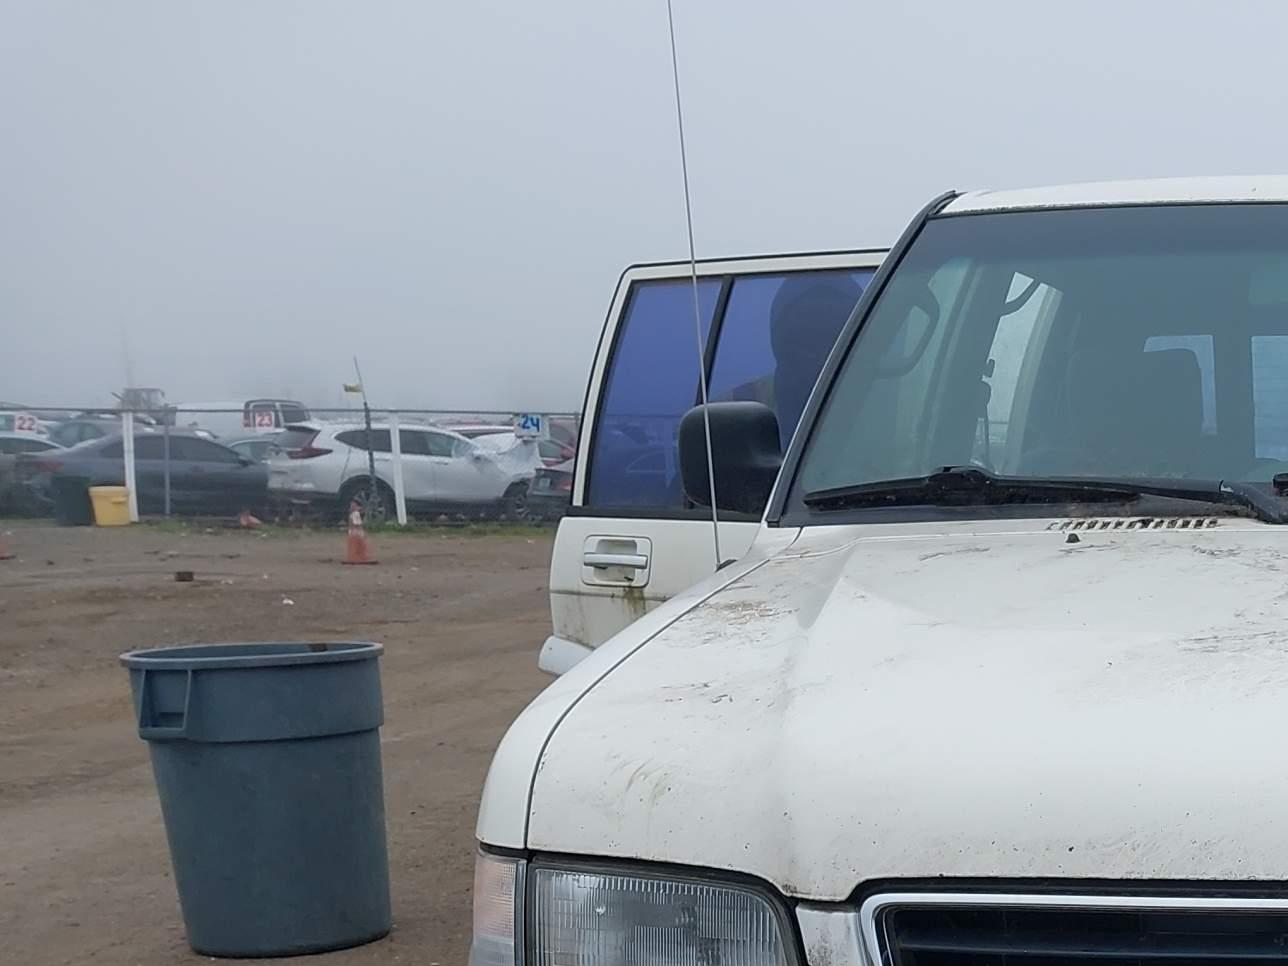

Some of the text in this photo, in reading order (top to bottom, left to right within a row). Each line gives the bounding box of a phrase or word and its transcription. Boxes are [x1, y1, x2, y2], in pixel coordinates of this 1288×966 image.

[16, 415, 36, 431] 22
[257, 411, 273, 427] 23
[520, 414, 540, 433] 24
